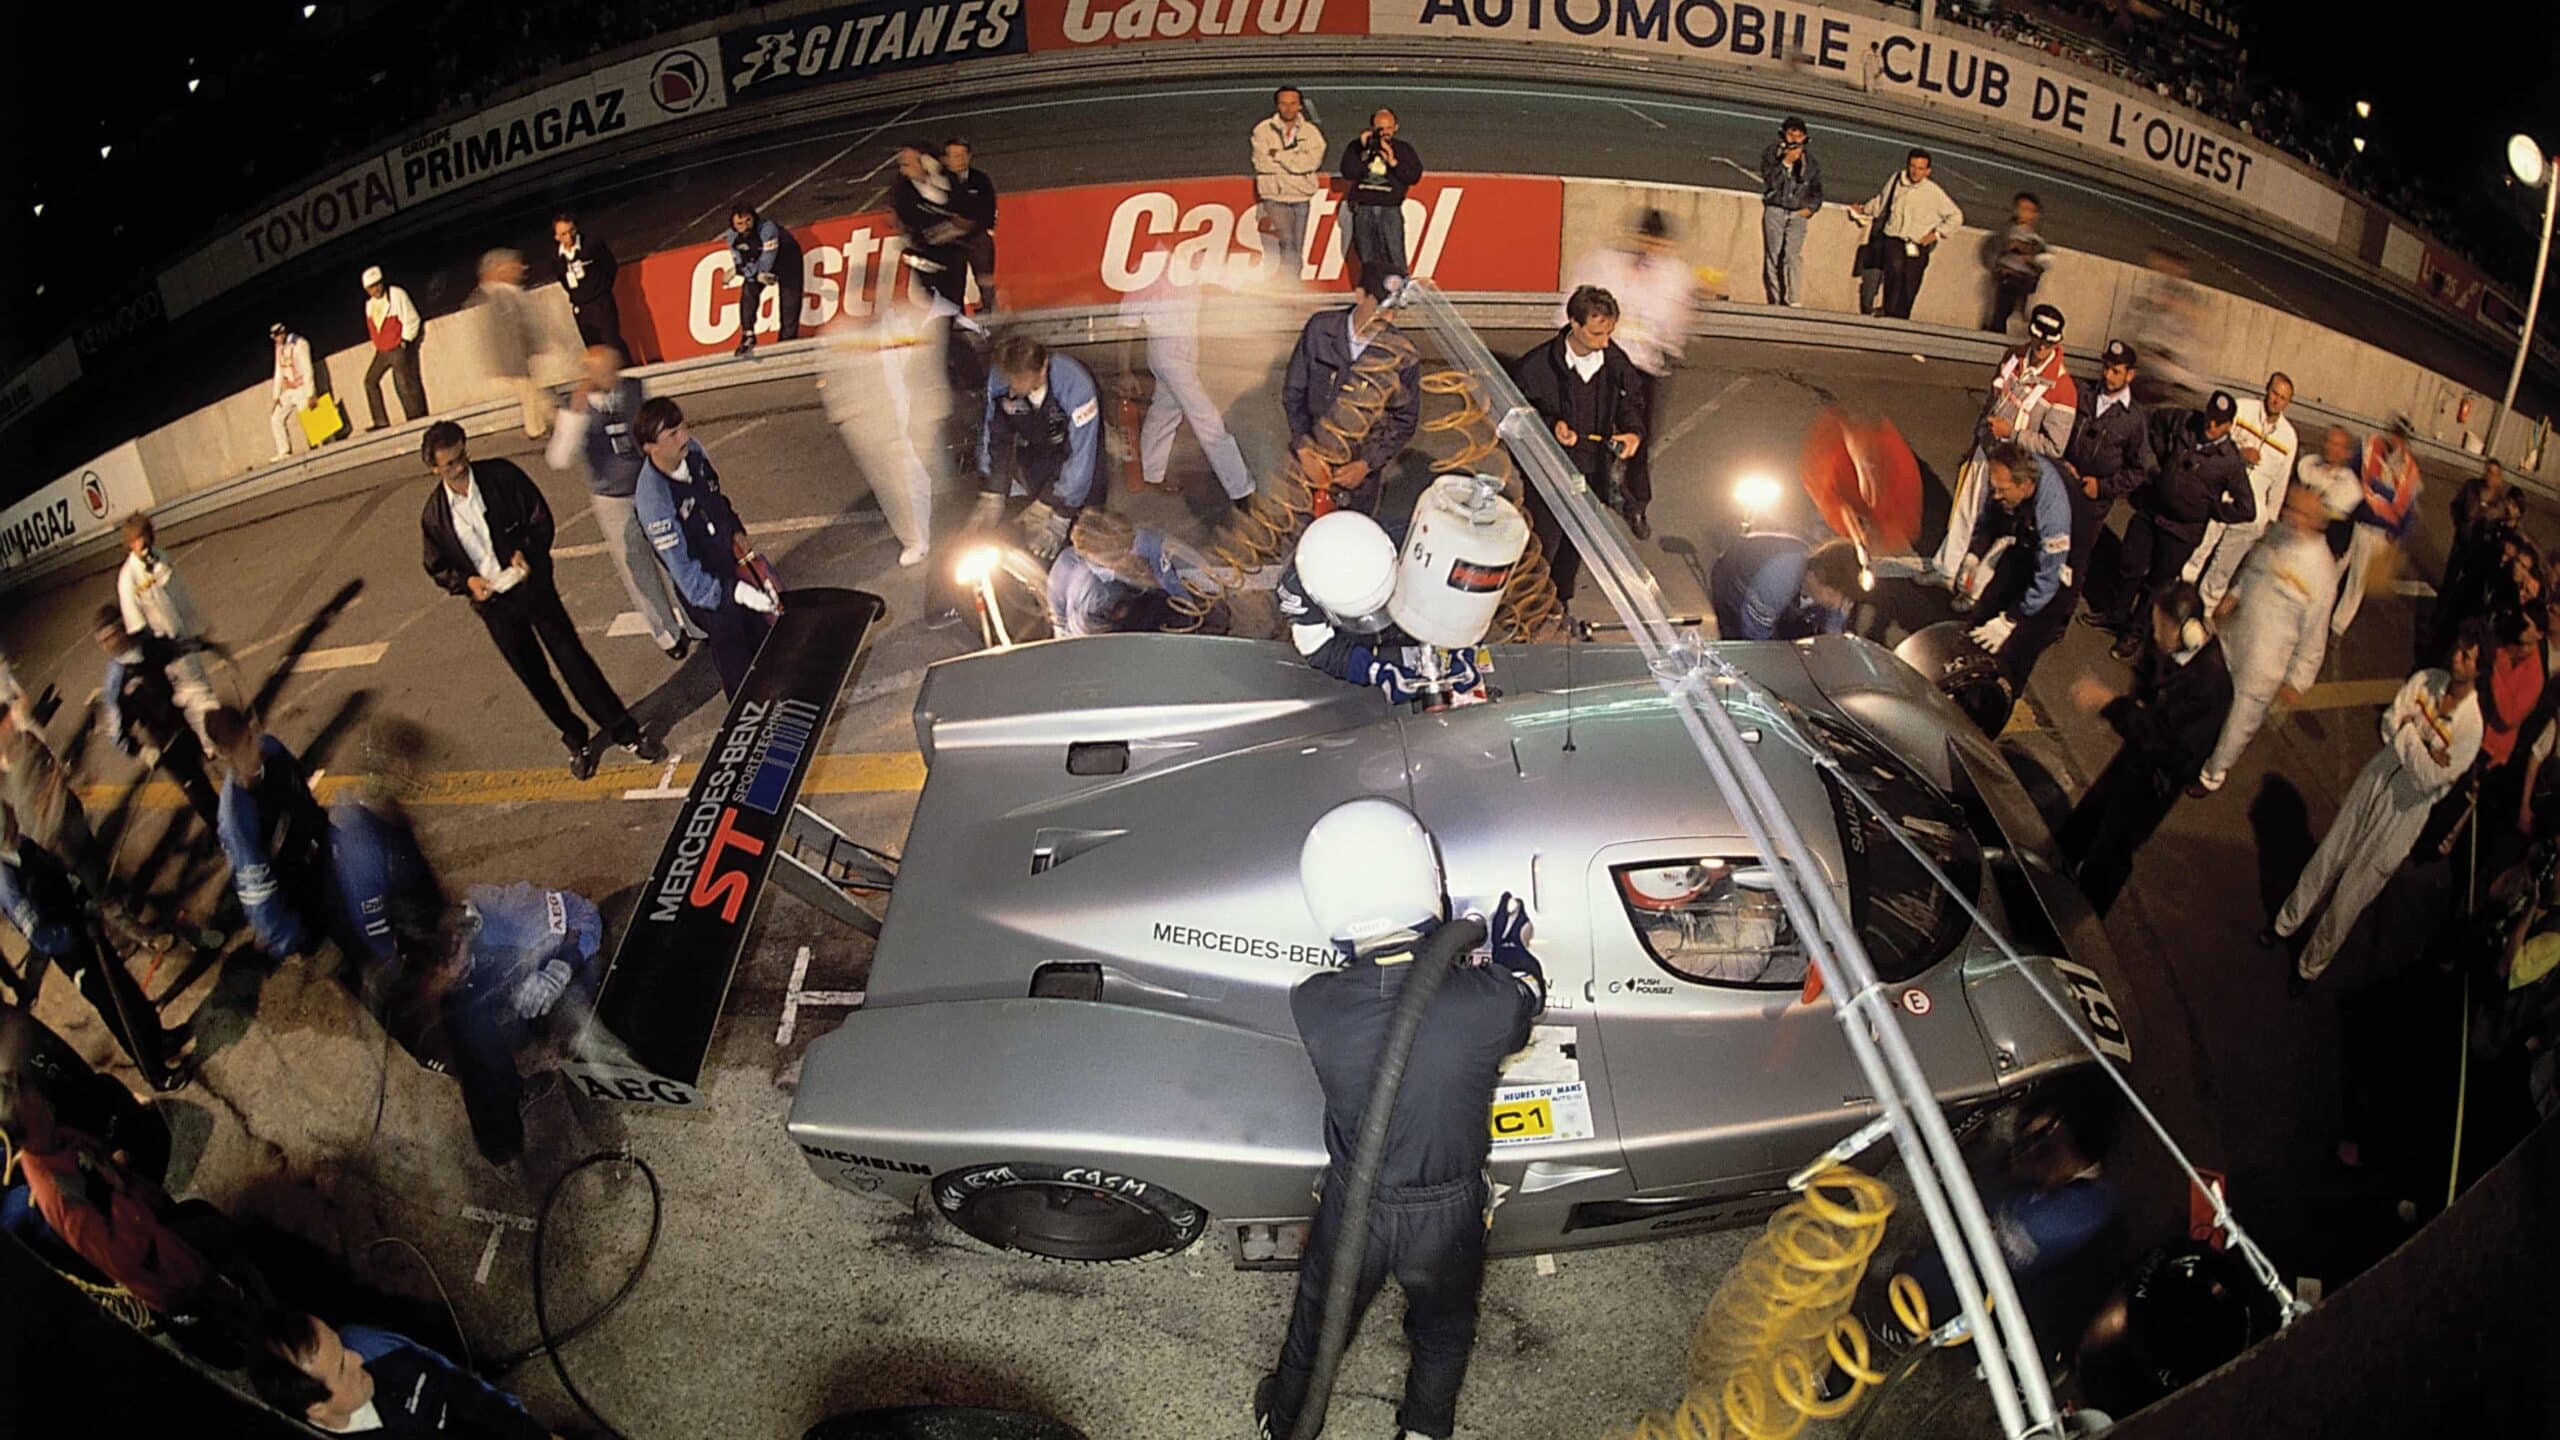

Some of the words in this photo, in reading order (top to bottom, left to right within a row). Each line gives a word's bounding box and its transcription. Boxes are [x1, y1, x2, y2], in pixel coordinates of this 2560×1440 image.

[796, 0, 1019, 77] GITANES
[1881, 36, 2010, 108] CLUB
[2032, 77, 2089, 133] DE
[2109, 102, 2253, 191] L'OUEST
[401, 129, 450, 157] GROUPE
[404, 90, 626, 198] PRIMAGAZ
[245, 171, 394, 263] TOYOTA
[0, 498, 76, 568] IMAGAZ
[650, 699, 771, 923] MERCEDES-BENZ
[690, 807, 764, 923] ST
[548, 895, 563, 932] AEG
[1636, 986, 1673, 995] POUSSEZ
[1637, 977, 1660, 986] PUSH
[1908, 993, 1925, 1010] E
[578, 1075, 692, 1105] AEG
[1504, 1090, 1535, 1101] HEURES
[1540, 1088, 1552, 1096] DU
[1557, 1083, 1581, 1093] MANS
[1494, 1107, 1545, 1133] C1
[801, 1144, 932, 1176] MICHELIN
